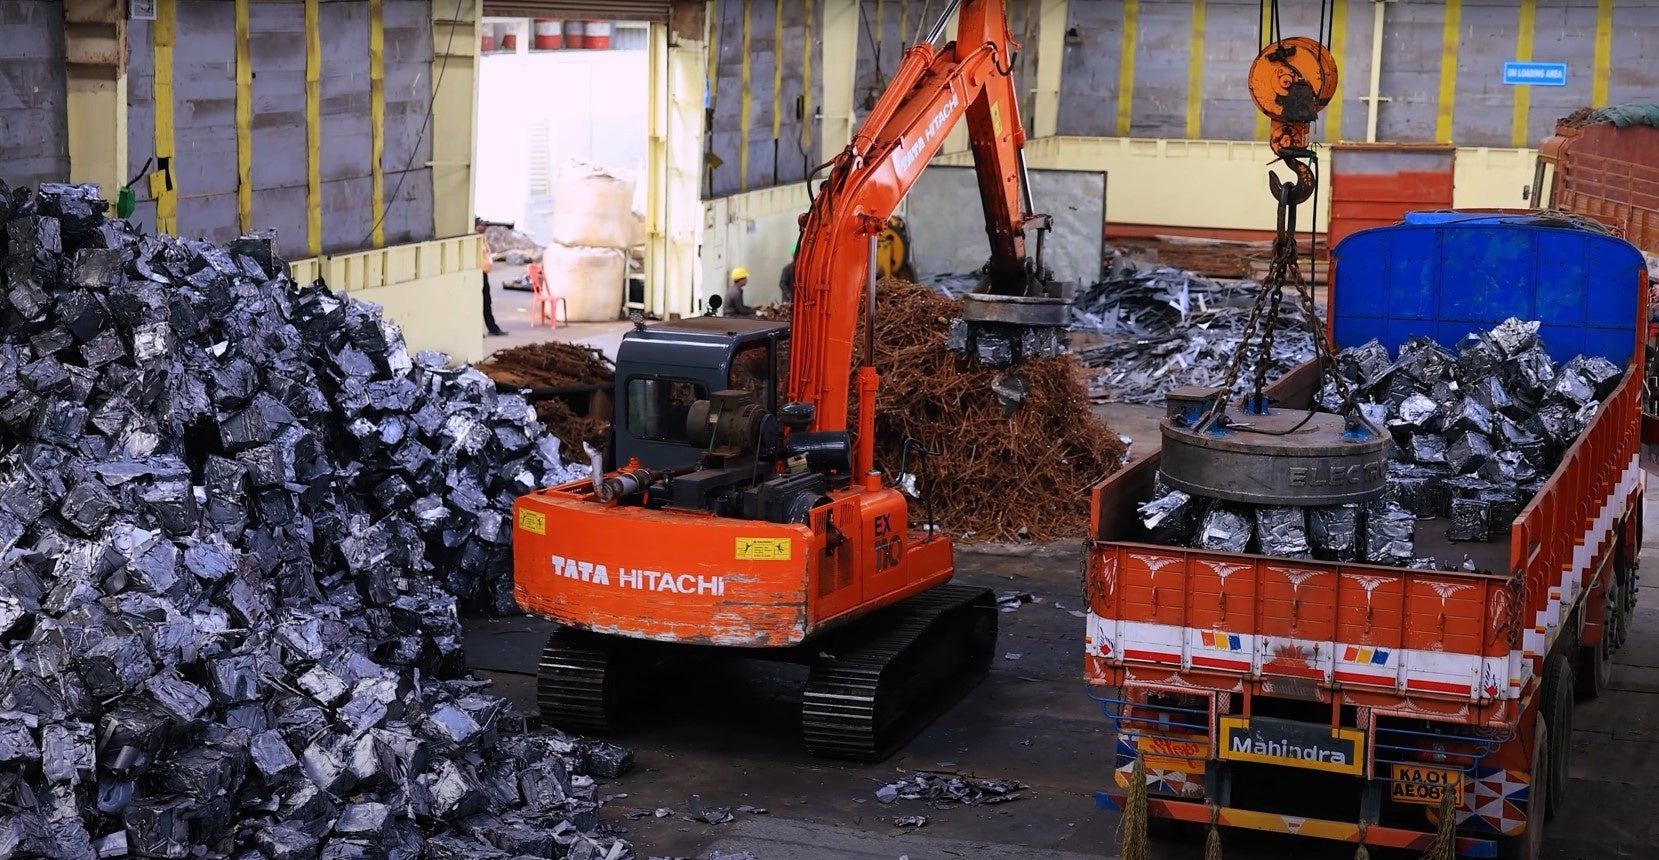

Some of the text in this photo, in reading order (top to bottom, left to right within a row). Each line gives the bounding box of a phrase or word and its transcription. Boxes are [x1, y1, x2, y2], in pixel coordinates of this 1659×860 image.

[1545, 69, 1563, 79] AREA
[925, 92, 959, 142] HITACHI
[874, 512, 892, 537] EX
[874, 534, 903, 573] 110
[551, 555, 725, 597] TATA HITACHI
[1232, 736, 1346, 765] Mahindra
